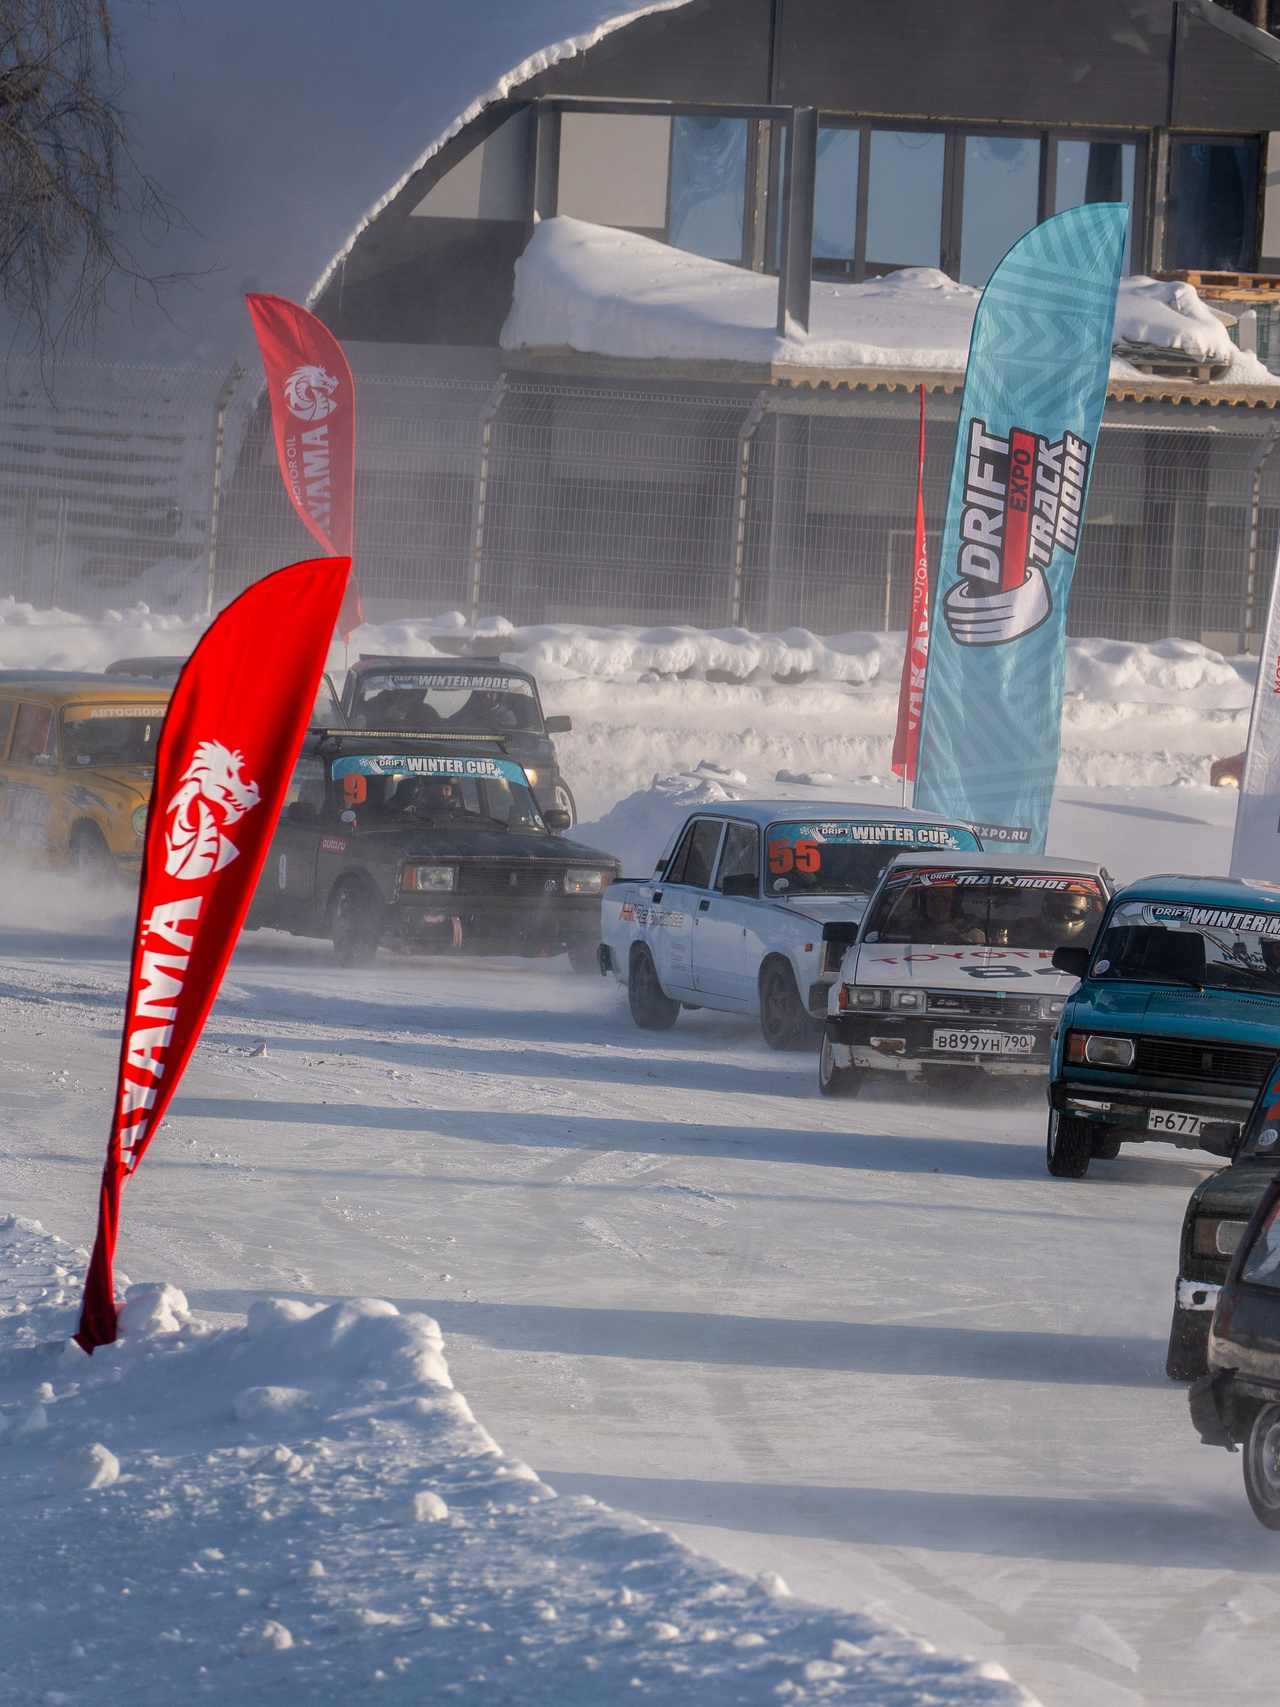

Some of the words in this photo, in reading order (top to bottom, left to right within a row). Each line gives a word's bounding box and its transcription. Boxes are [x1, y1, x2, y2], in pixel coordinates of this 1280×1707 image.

[286, 435, 296, 457] OIL
[1009, 448, 1031, 513] EXPO
[959, 420, 1011, 584] DRIFT
[1029, 438, 1064, 564] TRACK
[1055, 433, 1088, 551] MODE
[419, 675, 470, 688] WINTER
[471, 676, 509, 689] MODE
[91, 707, 167, 718] АВТОСПОРТ
[379, 758, 405, 767] DRIFT
[406, 757, 464, 774] WINTER
[466, 759, 495, 775] CUP
[343, 773, 367, 804] 9
[322, 838, 346, 851] auto.ru
[821, 827, 850, 835] DRIFT
[851, 826, 915, 842] WINTER
[917, 828, 949, 844] CUP
[768, 840, 821, 874] 55
[278, 853, 287, 890] 9
[930, 872, 956, 880] DRIFT
[956, 875, 1017, 886] TRACK
[1013, 877, 1069, 890] MODE
[1155, 907, 1190, 917] DRIFT
[1190, 908, 1267, 933] WINTER
[938, 1033, 1000, 1051] В899УН
[1003, 1035, 1027, 1048] 790
[1153, 1113, 1202, 1135] Р677
